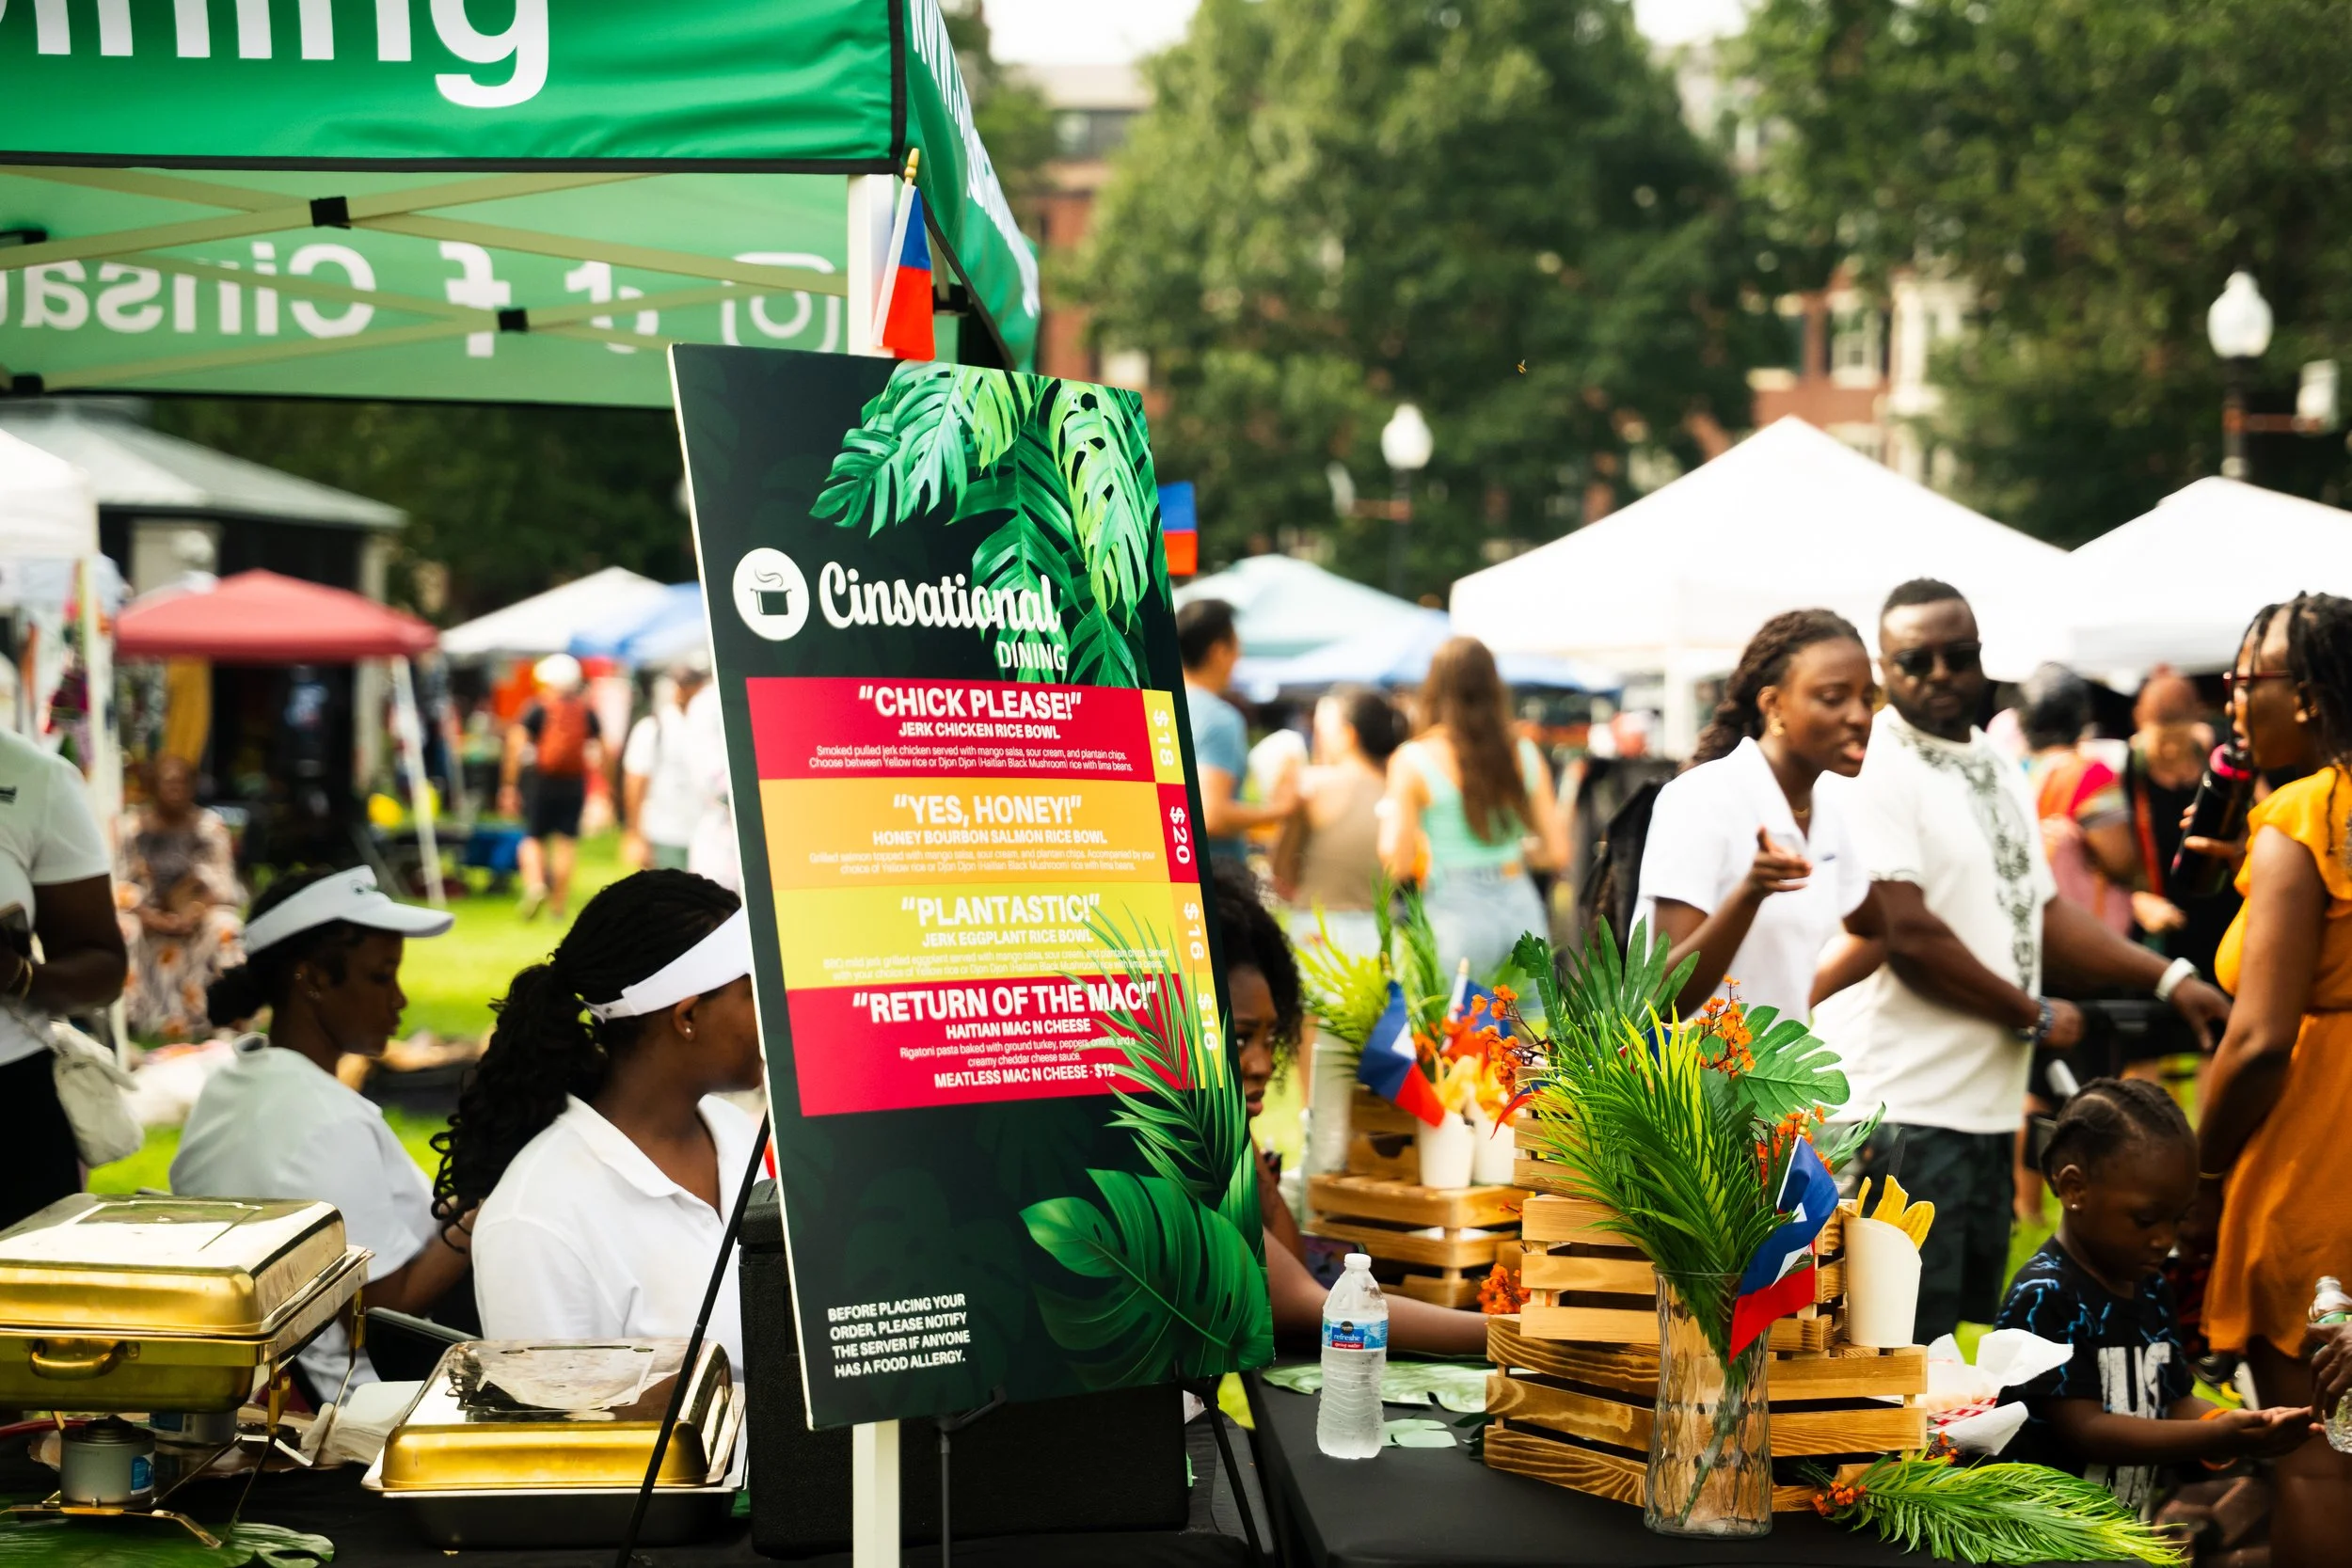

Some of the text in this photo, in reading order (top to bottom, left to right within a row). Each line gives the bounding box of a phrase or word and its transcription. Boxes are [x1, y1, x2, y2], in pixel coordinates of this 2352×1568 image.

[818, 562, 1061, 633] Cinsational
[997, 641, 1067, 671] DINING
[898, 721, 1060, 739] JERK CHICKEN RICE BOWL
[1153, 709, 1174, 767] $18
[809, 757, 843, 768] Choose
[844, 757, 882, 768] between
[883, 756, 911, 767] Yellow
[912, 756, 927, 766] rice
[938, 756, 957, 768] Djon
[958, 757, 977, 768] Djon
[978, 757, 1006, 768] (Haitian
[1008, 757, 1026, 768] Black
[1028, 758, 1068, 768] Mushroom)
[1069, 759, 1083, 768] rice
[1083, 760, 1097, 768] with
[1097, 761, 1111, 769] lima
[1112, 761, 1133, 770] beans.
[816, 745, 852, 755] Smoked
[853, 744, 881, 757] pulled
[882, 745, 897, 757] jerk
[898, 745, 930, 754] chicken
[931, 745, 958, 754] served
[959, 745, 977, 754] with
[977, 748, 1004, 757] mango
[1005, 746, 1024, 756] salsa,
[1042, 748, 1065, 757] cream,
[1066, 748, 1080, 757] and
[1081, 749, 1107, 759] plantain
[1107, 750, 1127, 760] chips.
[872, 829, 1106, 846] HONEY BOURBON SALMON RICE BOWL
[1169, 806, 1191, 864] $20
[921, 927, 1093, 947] JERK EGGPLANT RICE BOWL
[1184, 903, 1204, 959] $16
[992, 985, 1028, 1017] OF
[1030, 983, 1083, 1014] THE
[946, 1017, 1090, 1038] HAITIAN MAC N CHEESE
[1197, 993, 1218, 1051] $16
[899, 1045, 934, 1060] Rigatoni
[936, 1044, 959, 1057] pasta
[960, 1042, 984, 1054] baked
[985, 1040, 1003, 1053] with
[1004, 1039, 1032, 1053] ground
[1033, 1038, 1057, 1053] turkey,
[1117, 1035, 1129, 1045] and
[967, 1051, 1081, 1069] creamy cheddar cheese sauce.
[933, 1069, 1001, 1088] MEATLESS
[1002, 1068, 1030, 1084] MAC
[1031, 1068, 1041, 1081] N
[1042, 1064, 1088, 1081] CHEESE
[1094, 1062, 1115, 1078] $12
[828, 1293, 965, 1322] BEFORE PLACING YOUR
[830, 1312, 967, 1340] ORDER, PLEASE NOTIFY
[833, 1330, 970, 1359] THE SERVER IF ANYONE
[834, 1350, 966, 1378] HAS A FOOD ALLERGY.
